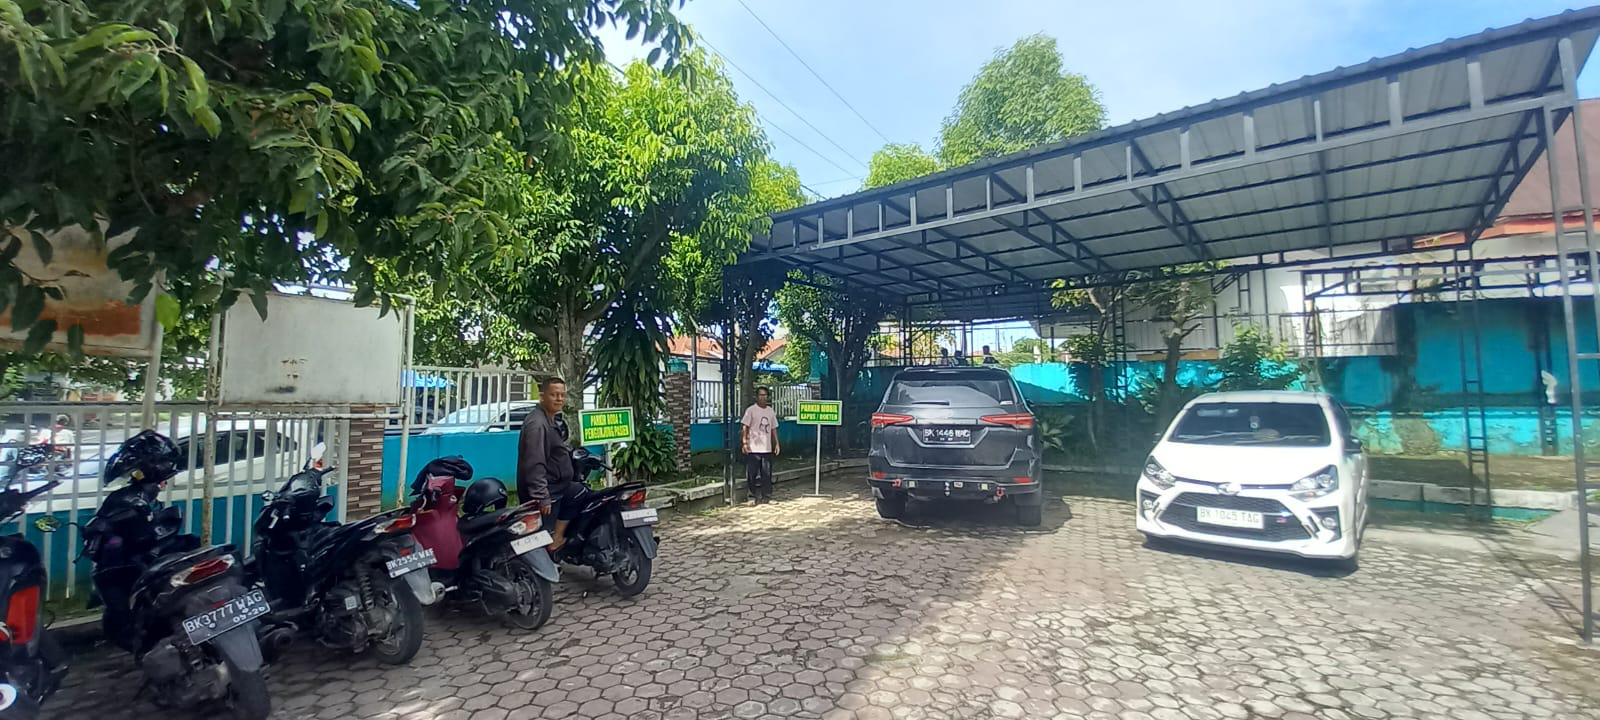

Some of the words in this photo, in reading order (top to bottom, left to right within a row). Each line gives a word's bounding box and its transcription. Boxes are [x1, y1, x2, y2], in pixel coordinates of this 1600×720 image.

[821, 404, 837, 413] MOBIL
[591, 414, 606, 426] PARKIR
[235, 592, 262, 610] WAG
